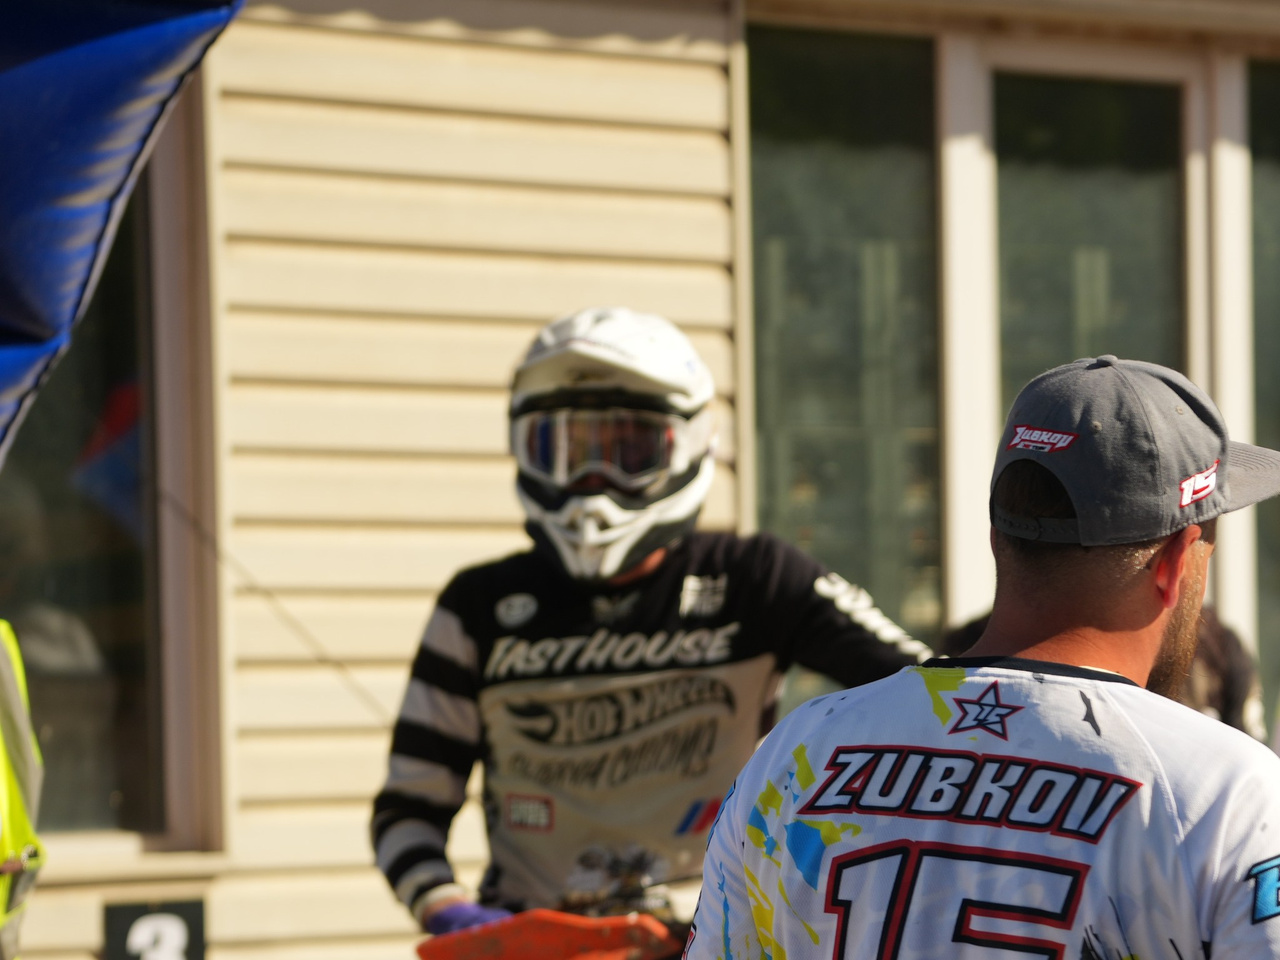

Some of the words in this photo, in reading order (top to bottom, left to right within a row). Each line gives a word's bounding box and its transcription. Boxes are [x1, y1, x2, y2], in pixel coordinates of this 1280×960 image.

[1179, 460, 1219, 507] 15
[484, 622, 741, 678] FASTHOUSE
[804, 746, 1138, 840] ZUBKOV
